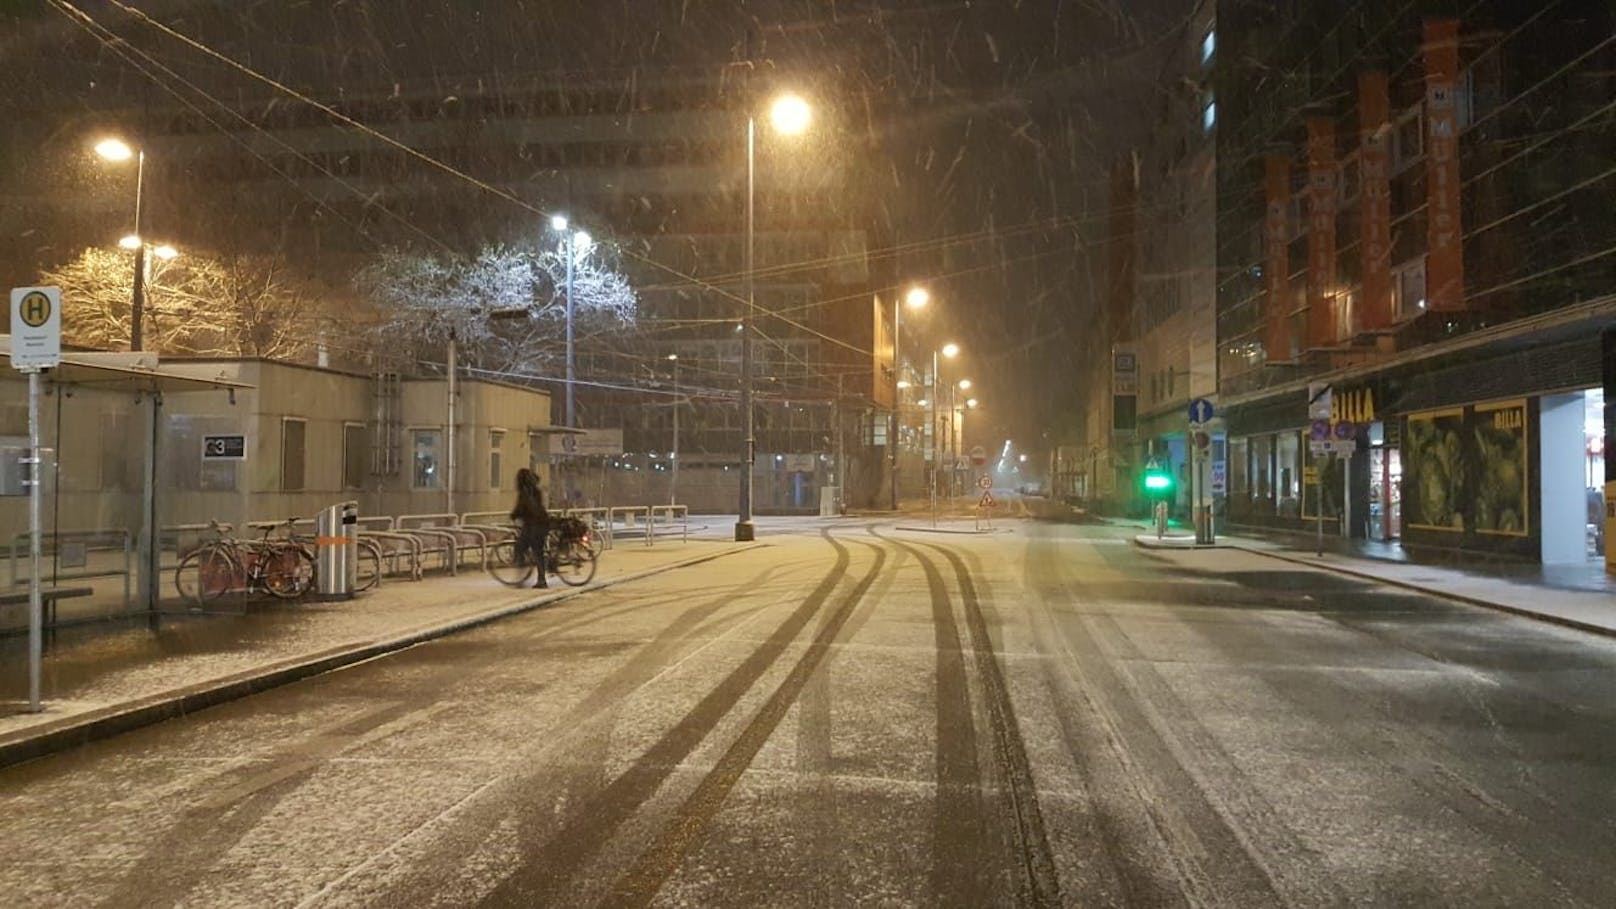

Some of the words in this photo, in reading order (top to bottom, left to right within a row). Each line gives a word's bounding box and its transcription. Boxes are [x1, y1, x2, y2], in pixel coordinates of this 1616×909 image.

[28, 298, 43, 321] H
[1329, 387, 1374, 426] BILLA
[1494, 408, 1521, 429] BILLA
